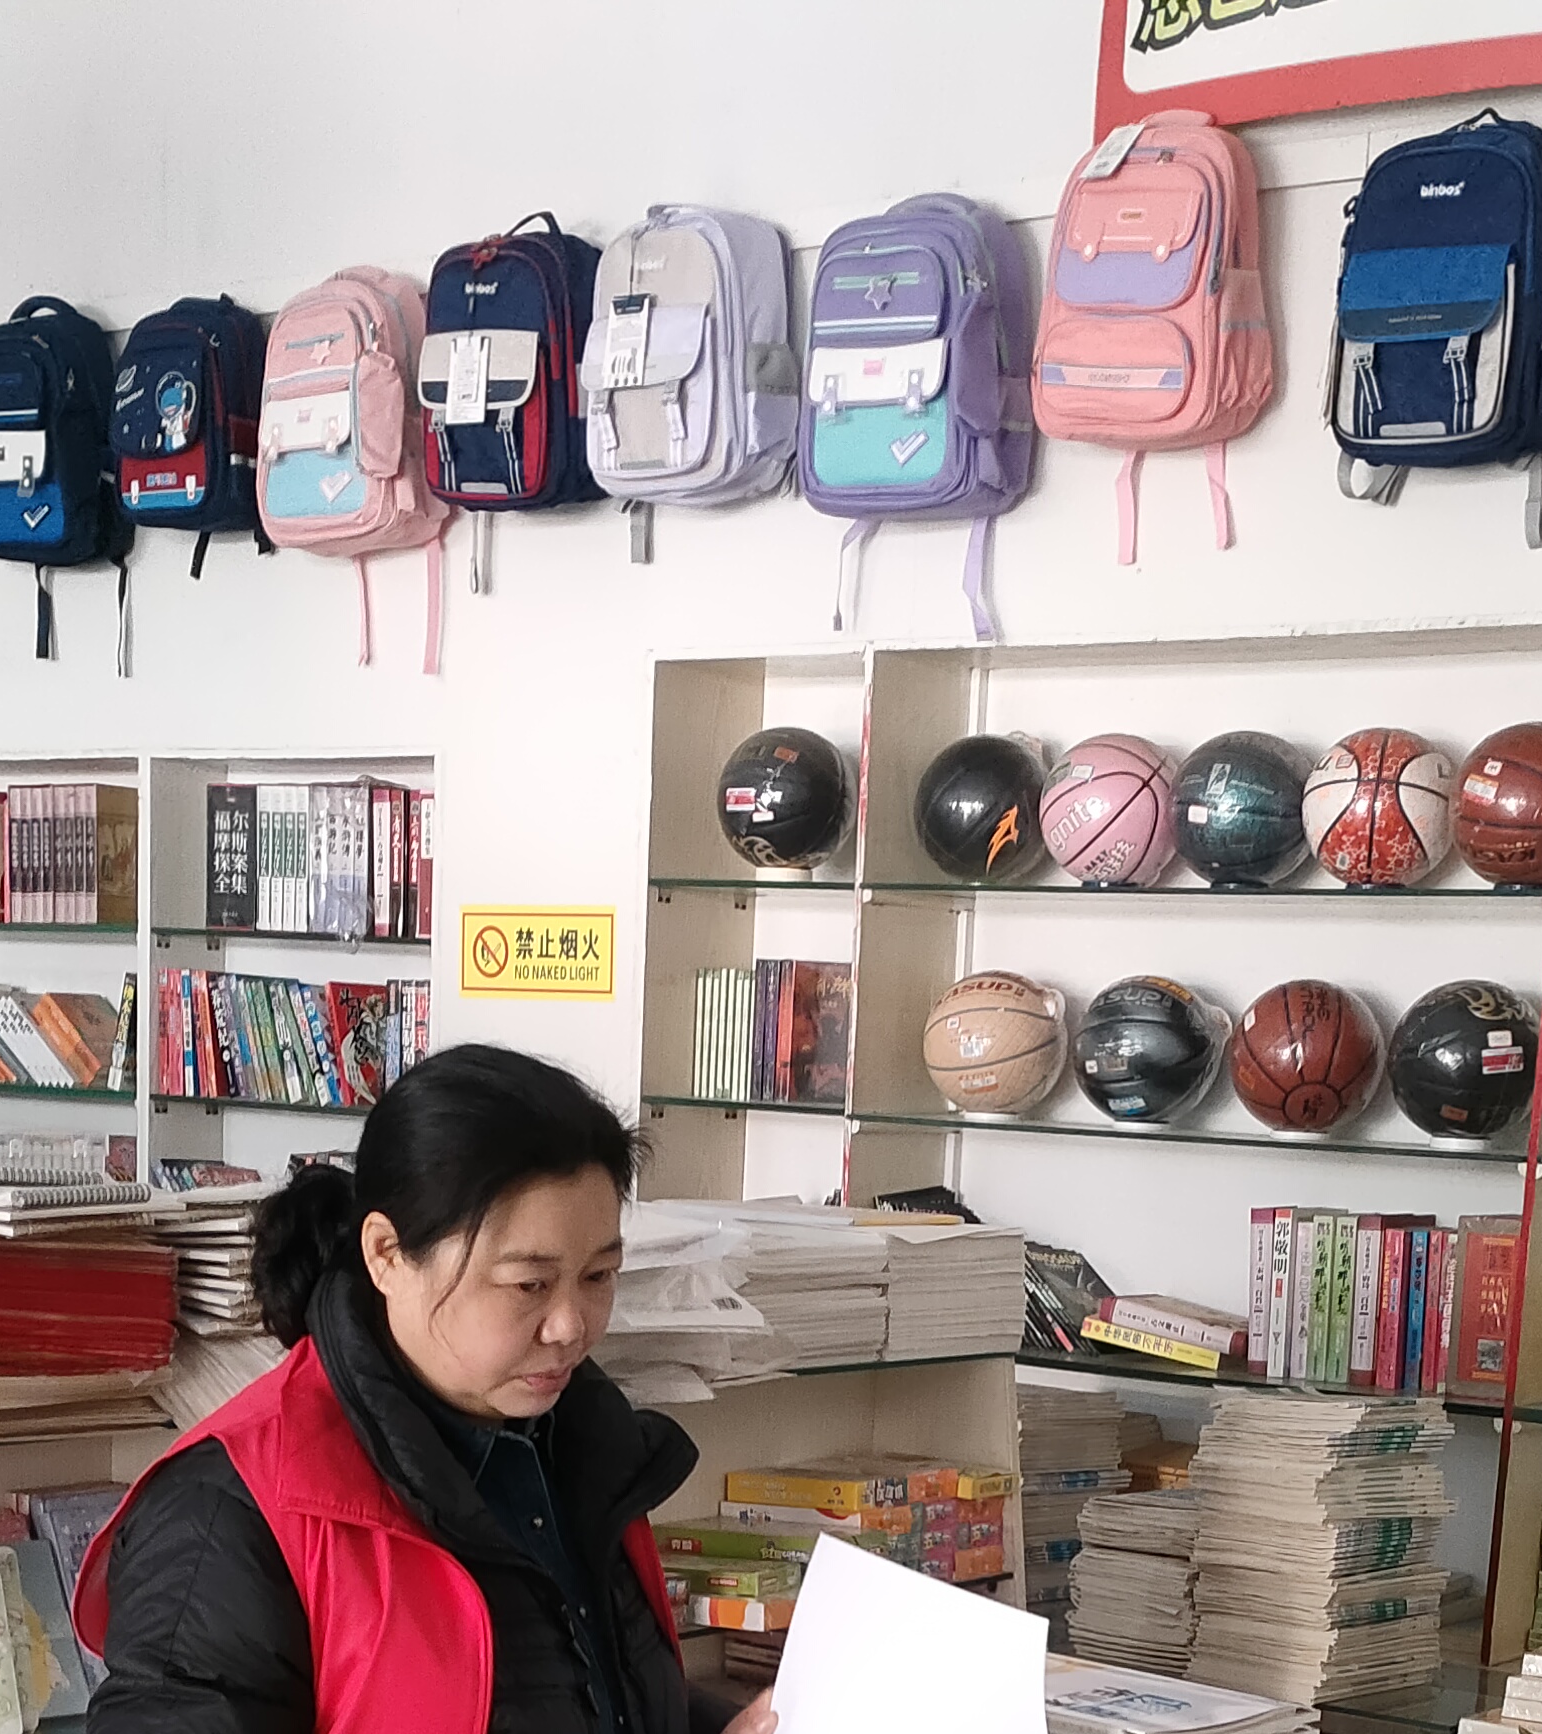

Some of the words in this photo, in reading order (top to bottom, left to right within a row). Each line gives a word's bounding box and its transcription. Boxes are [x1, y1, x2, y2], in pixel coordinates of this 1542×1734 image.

[515, 926, 600, 961] 禁止烟火
[514, 965, 530, 980] NO
[532, 965, 567, 981] NAKED
[569, 966, 600, 982] LIGHT
[1274, 1220, 1290, 1275] 郭敬明
